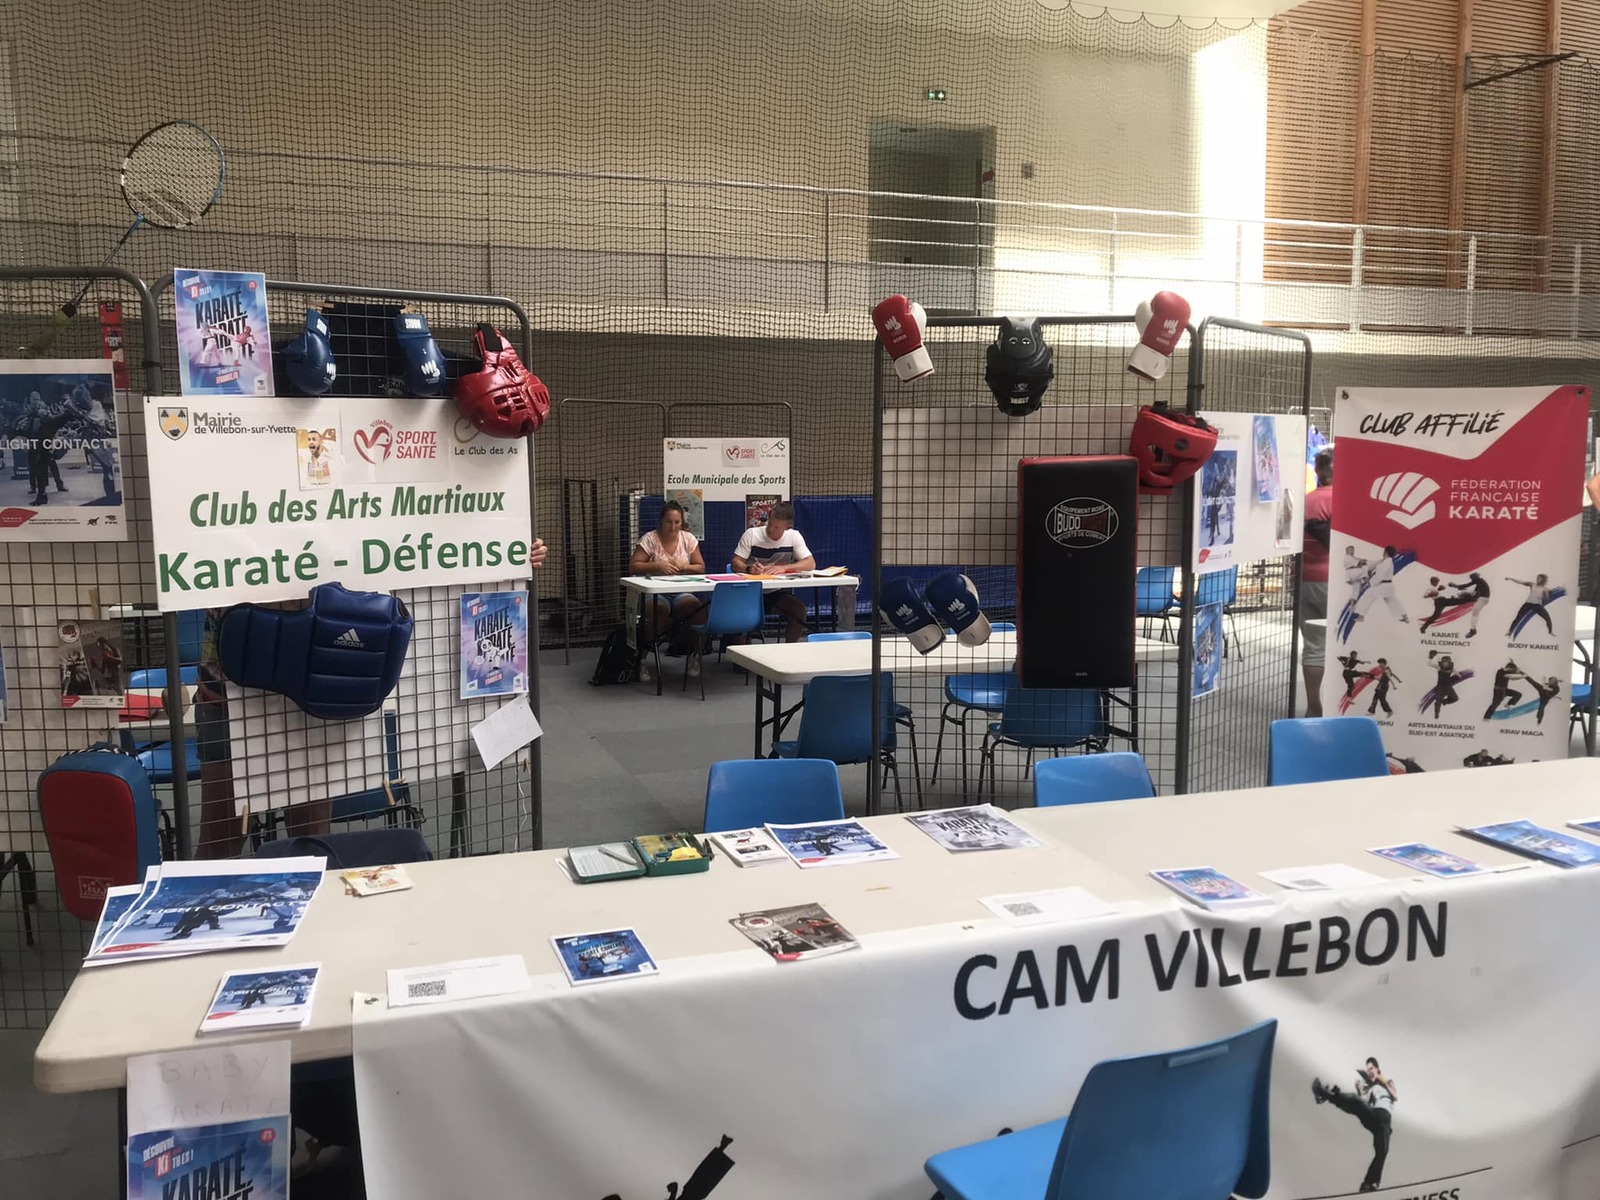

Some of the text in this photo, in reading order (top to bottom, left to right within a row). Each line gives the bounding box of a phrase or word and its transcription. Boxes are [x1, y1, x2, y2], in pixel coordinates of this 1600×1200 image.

[194, 412, 241, 427] Mairie
[1360, 411, 1414, 436] CLUB
[194, 425, 296, 434] de Villebon-sur-Yvette
[396, 431, 437, 444] SPORT
[42, 438, 108, 450] CONTACT
[455, 446, 465, 455] Le
[468, 446, 486, 455] Club
[490, 446, 503, 454] des
[667, 474, 786, 486] Ecole Municipale des Sports
[1451, 478, 1541, 490] FÉDÉRATION
[1450, 492, 1540, 503] FRANÇAISE
[189, 484, 505, 527] Club des Arts Martiaux
[1449, 503, 1539, 520] KARATÉ
[1057, 513, 1081, 533] BUDO
[158, 541, 319, 592] Karaté
[362, 532, 527, 574] Défense
[333, 639, 364, 648] adidas
[1439, 731, 1475, 739] ASIATIQUE
[146, 905, 202, 915] LIGHT
[953, 901, 1448, 1020] CAM VILLEBON
